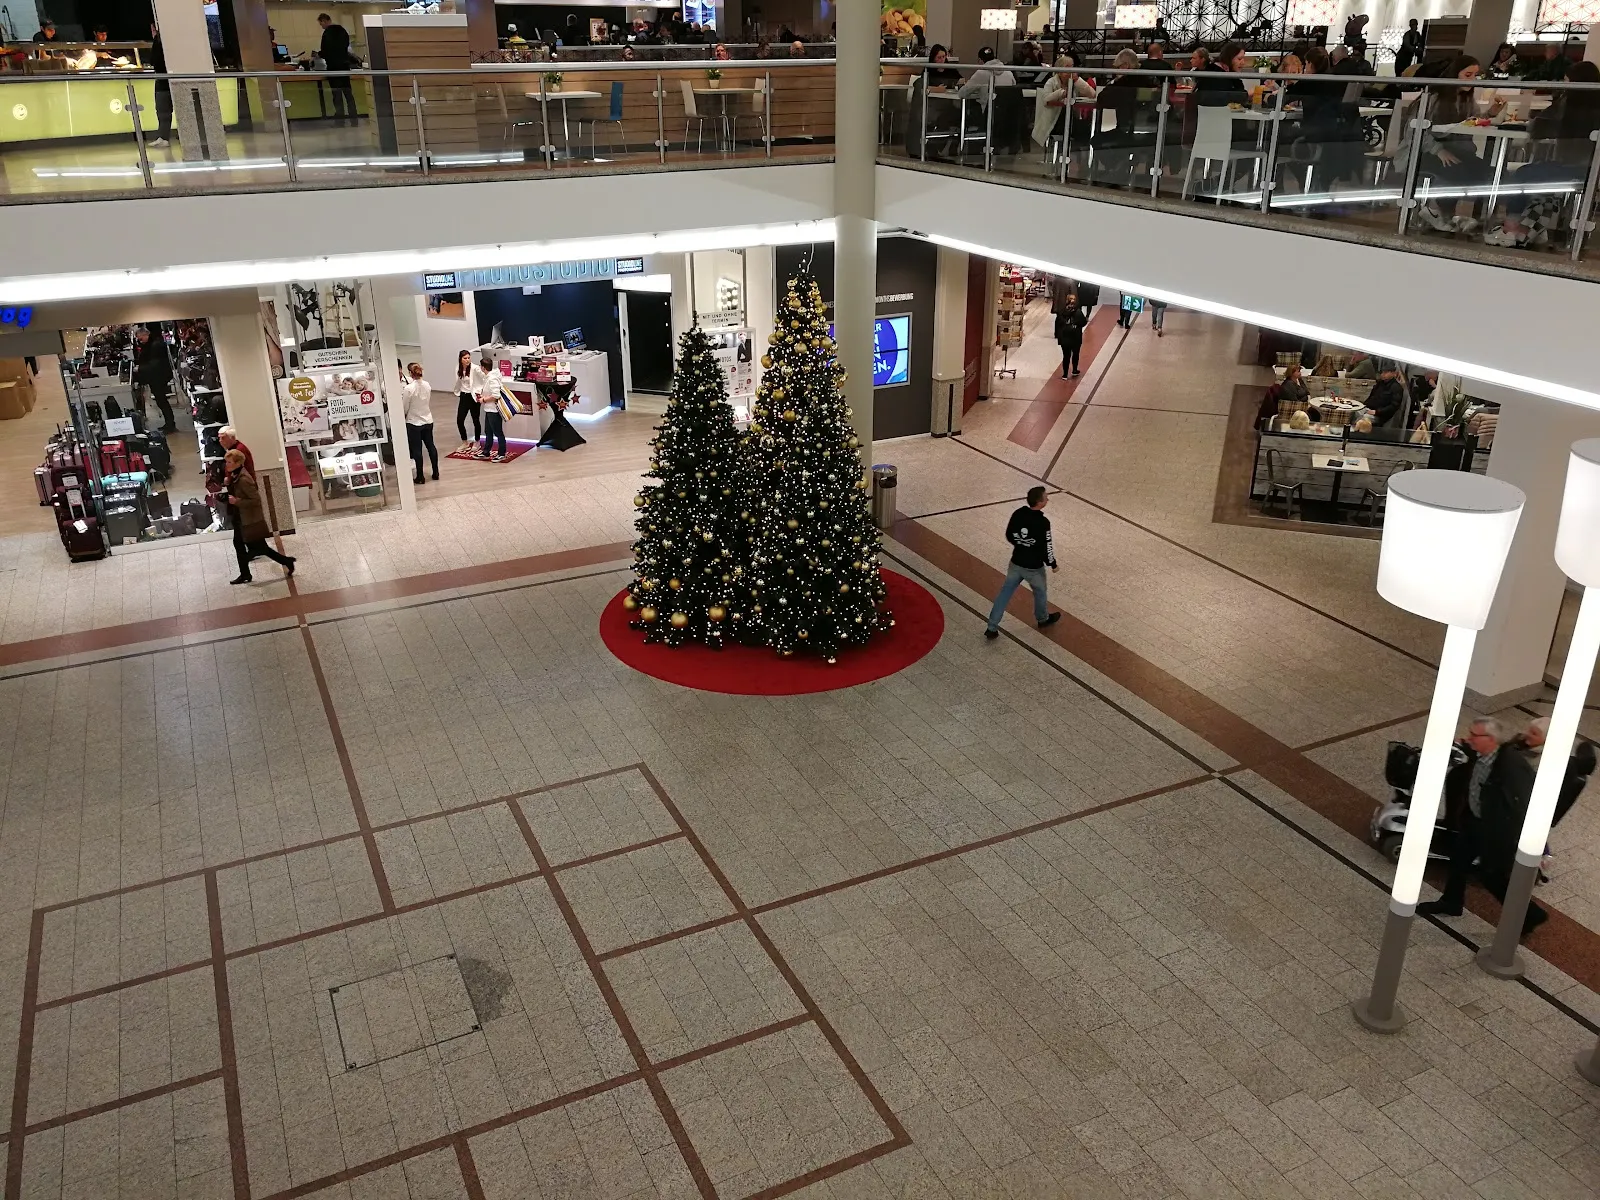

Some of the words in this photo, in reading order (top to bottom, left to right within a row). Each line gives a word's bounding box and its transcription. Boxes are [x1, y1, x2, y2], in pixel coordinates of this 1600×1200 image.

[315, 355, 353, 363] VERSCHENKEN
[330, 398, 346, 407] FOTO-
[331, 405, 359, 414] SHOOTING
